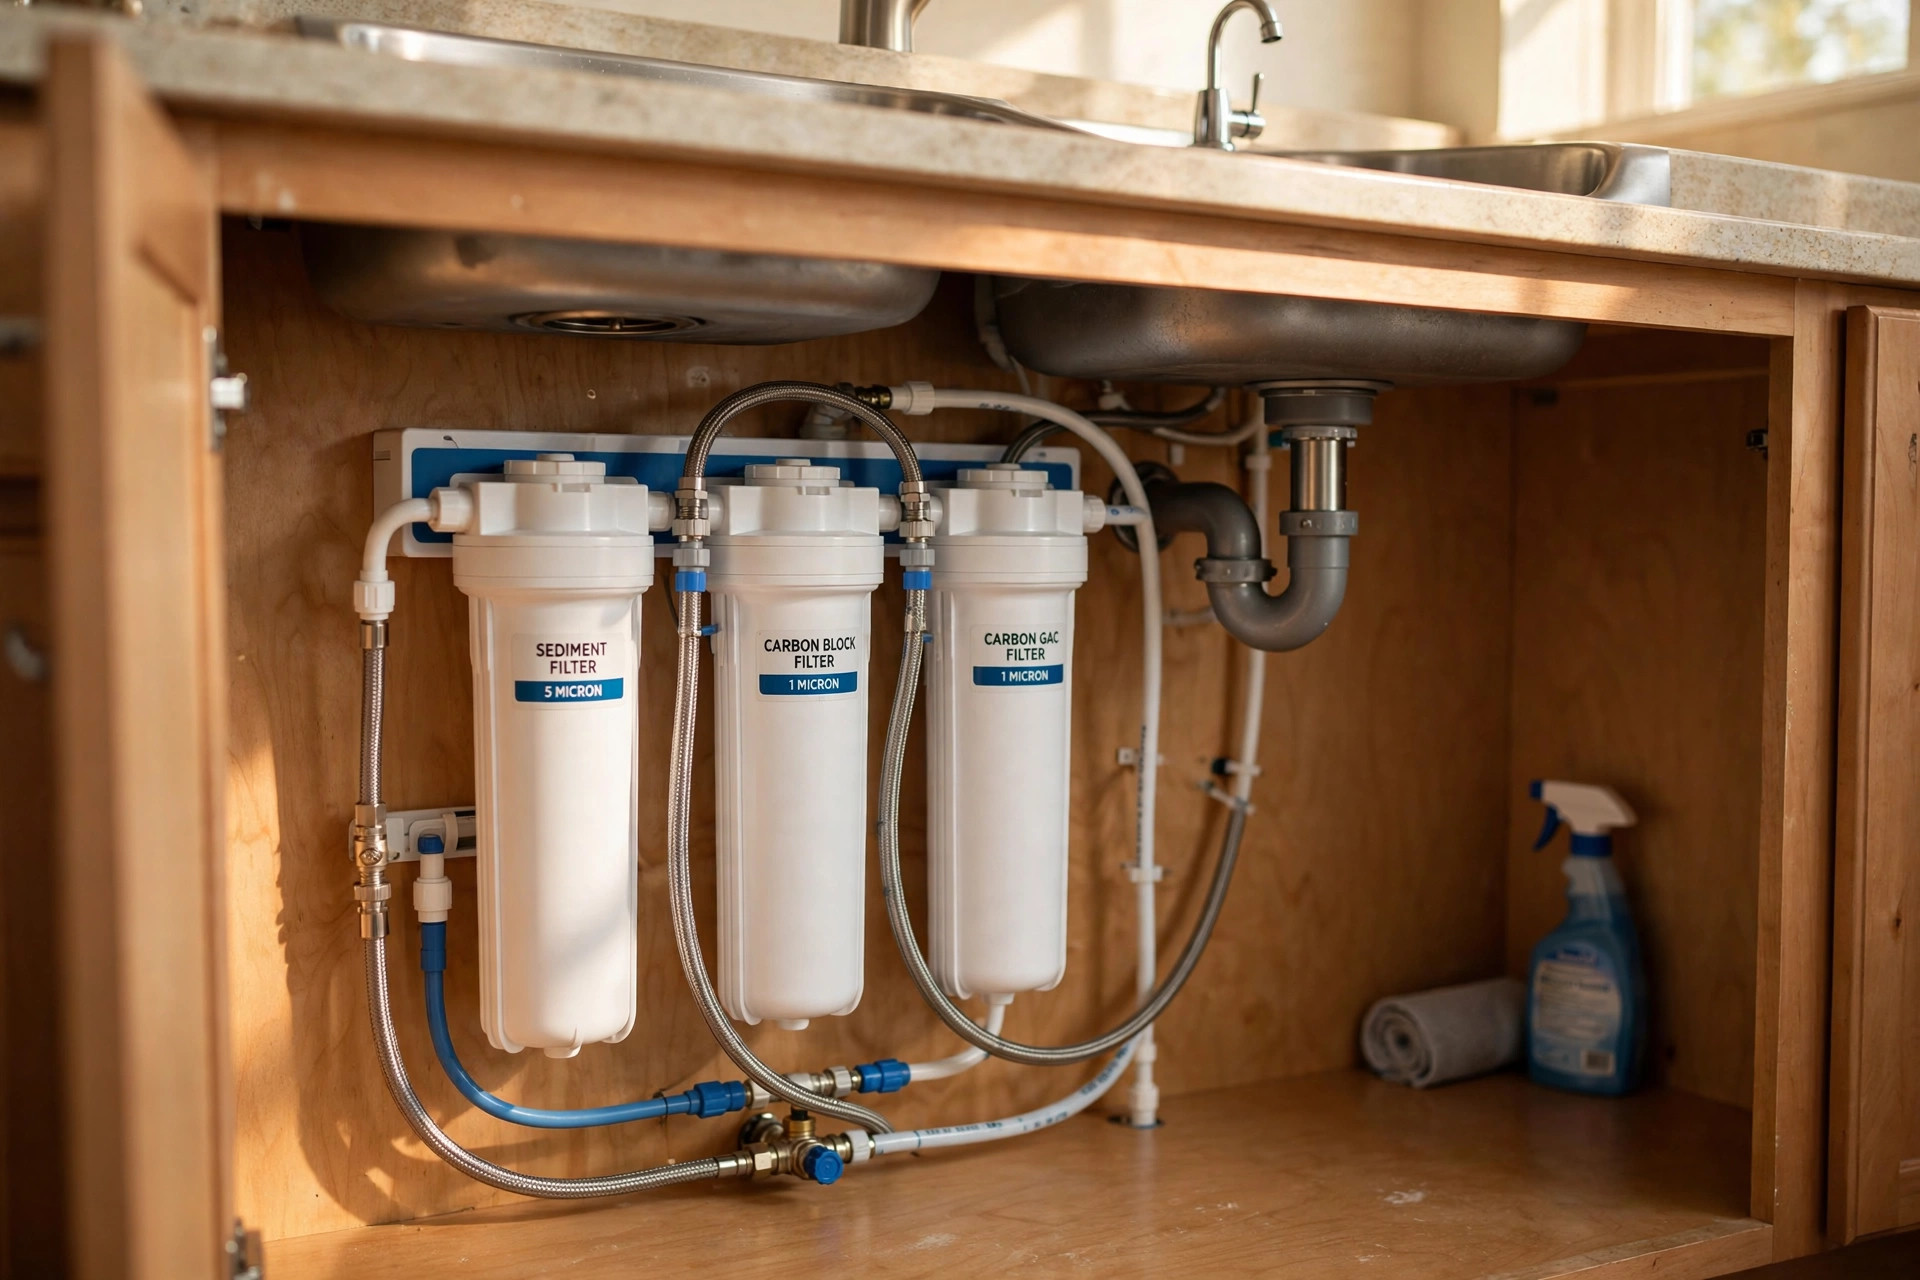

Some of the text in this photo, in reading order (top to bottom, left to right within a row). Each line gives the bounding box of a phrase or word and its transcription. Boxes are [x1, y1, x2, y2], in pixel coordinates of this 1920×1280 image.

[764, 636, 856, 652] CARBON BLOCK
[984, 631, 1059, 645] CARBON GAC
[536, 642, 607, 657] SEDIMENT
[1006, 647, 1045, 661] FILTER
[550, 660, 597, 674] FILTER
[794, 654, 834, 669] FILTER
[1001, 670, 1049, 682] 1 MICRON
[544, 684, 602, 698] 5 MICRON
[789, 678, 839, 690] 1 MICRON
